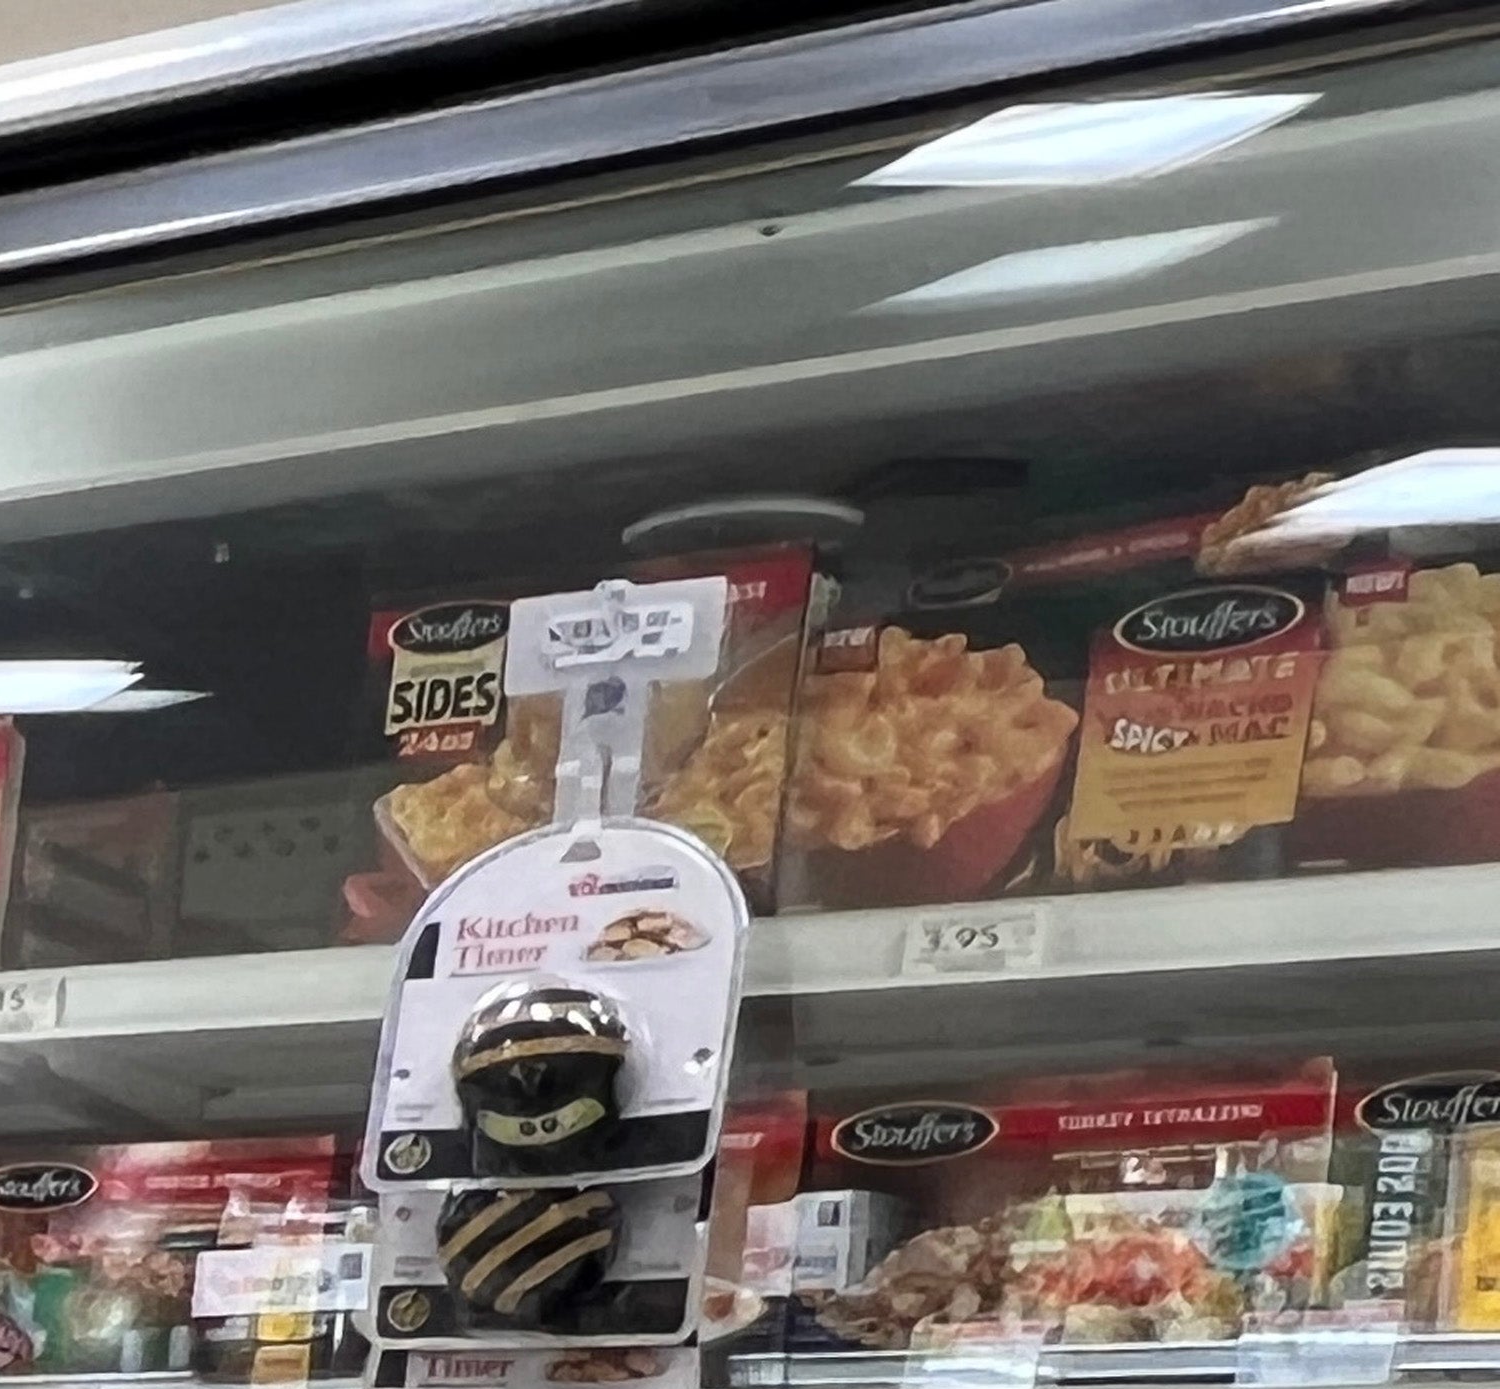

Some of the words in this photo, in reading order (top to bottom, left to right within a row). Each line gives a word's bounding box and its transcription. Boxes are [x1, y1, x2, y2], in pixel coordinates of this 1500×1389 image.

[390, 671, 498, 724] SIDES
[456, 910, 581, 944] Kitchen
[456, 943, 550, 970] Timer
